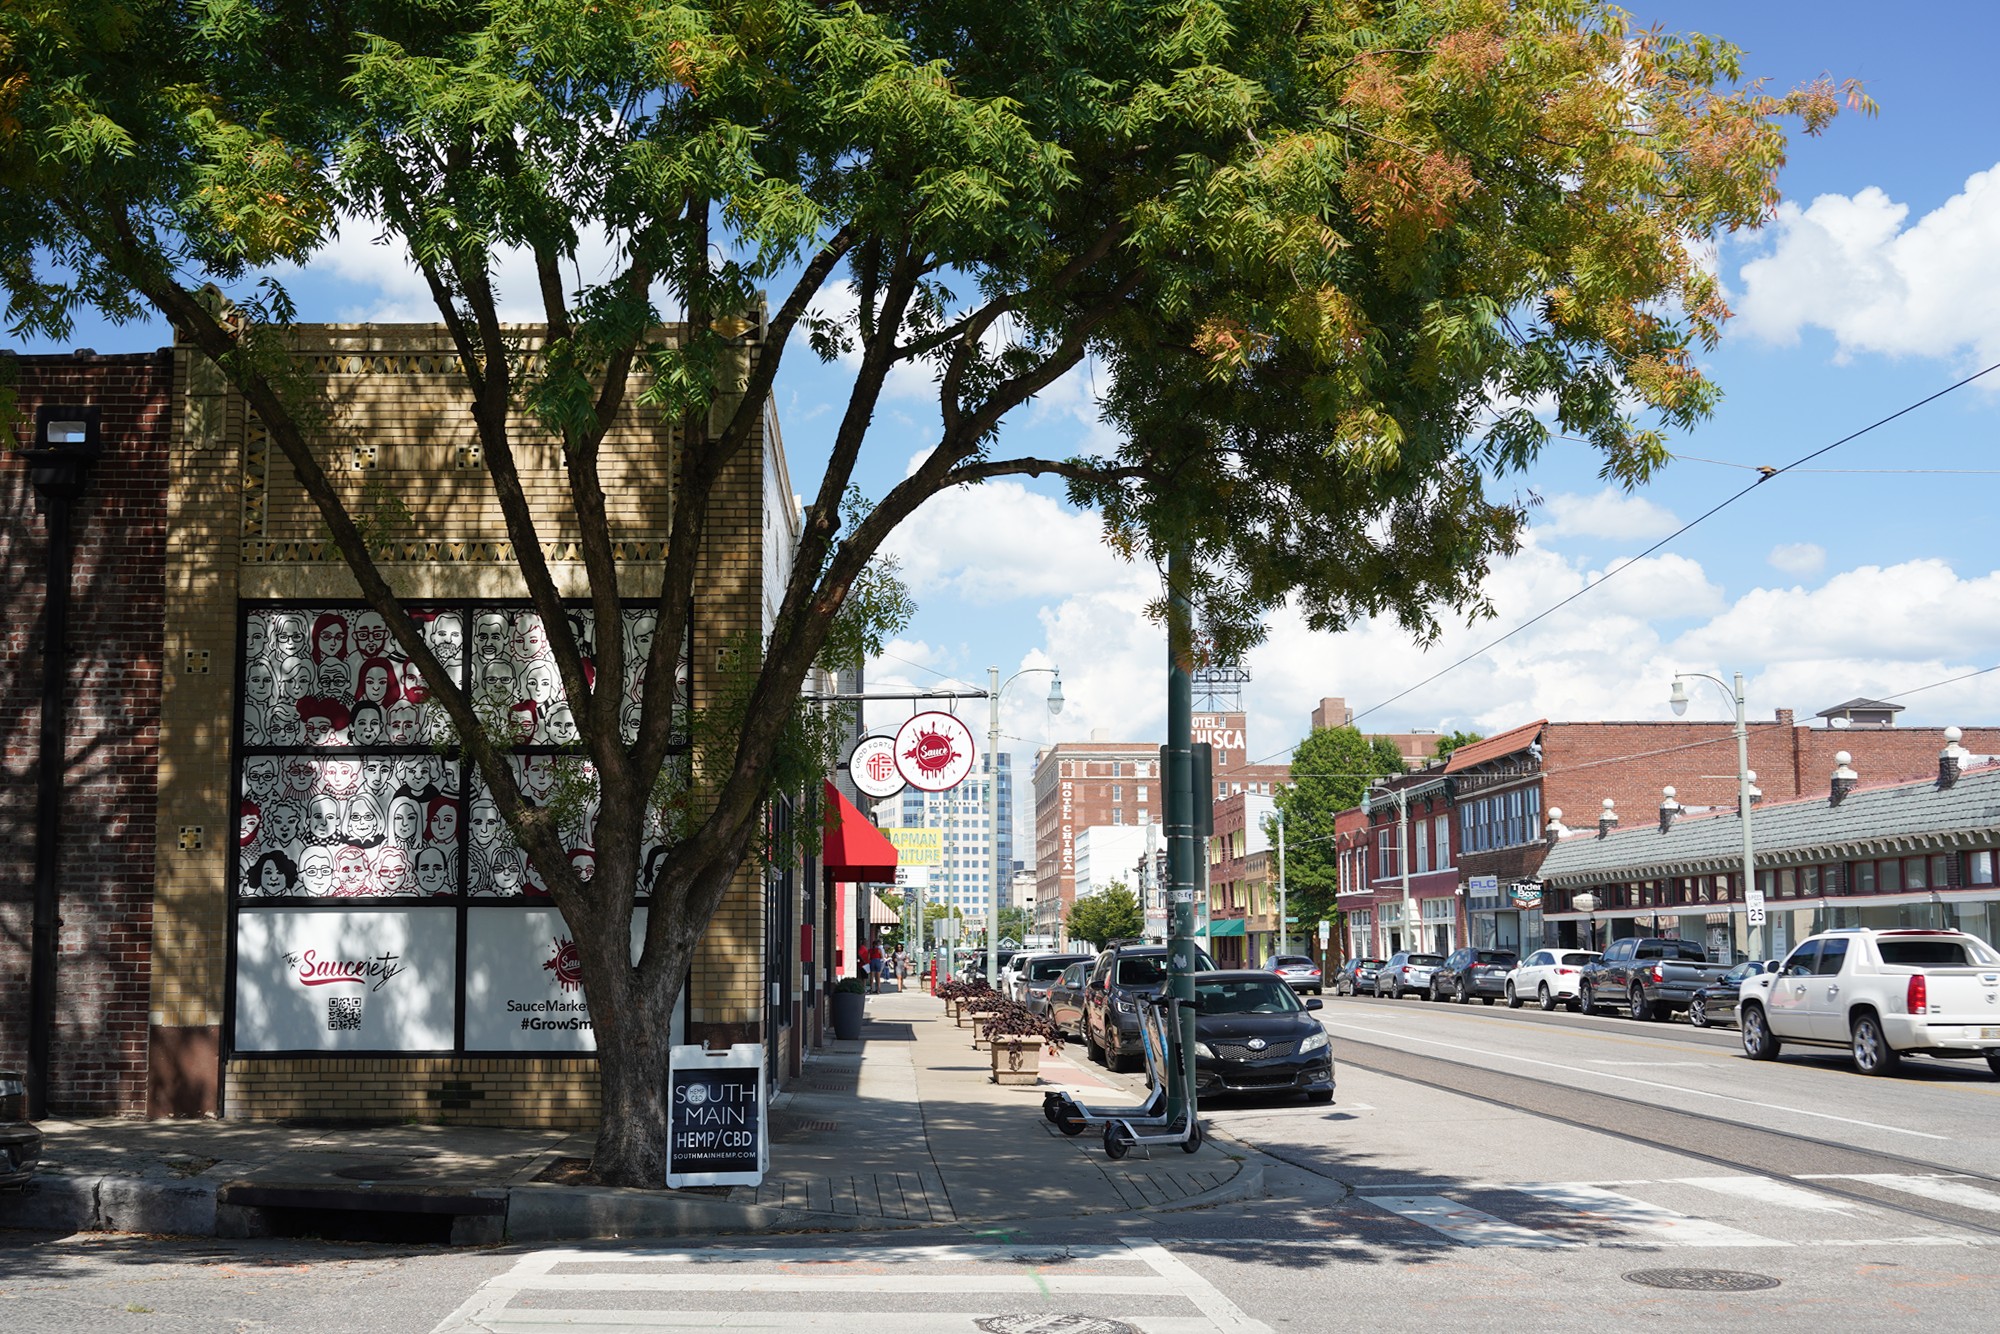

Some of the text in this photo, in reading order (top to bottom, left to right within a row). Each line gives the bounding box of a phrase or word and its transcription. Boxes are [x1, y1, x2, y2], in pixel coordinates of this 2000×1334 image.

[1192, 716, 1218, 729] OTEL
[855, 741, 894, 769] GOOD FORTU
[920, 745, 949, 759] Sauce
[1062, 782, 1074, 870] HOTEL CHISCA
[883, 832, 937, 847] HAPMAN
[897, 849, 940, 863] NITURE
[1470, 880, 1496, 889] FLC
[1511, 883, 1542, 893] Tinder
[1517, 890, 1539, 898] Box
[1750, 909, 1764, 921] 25
[561, 956, 580, 970] Sau
[507, 999, 588, 1012] SauceMarke
[521, 1018, 592, 1030] #GrowSm
[690, 1094, 703, 1102] CBD
[685, 1106, 744, 1126] MAIN
[677, 1129, 753, 1149] HEMP/CBD
[673, 1151, 756, 1160] SOUTHMAINHEMP.COM
